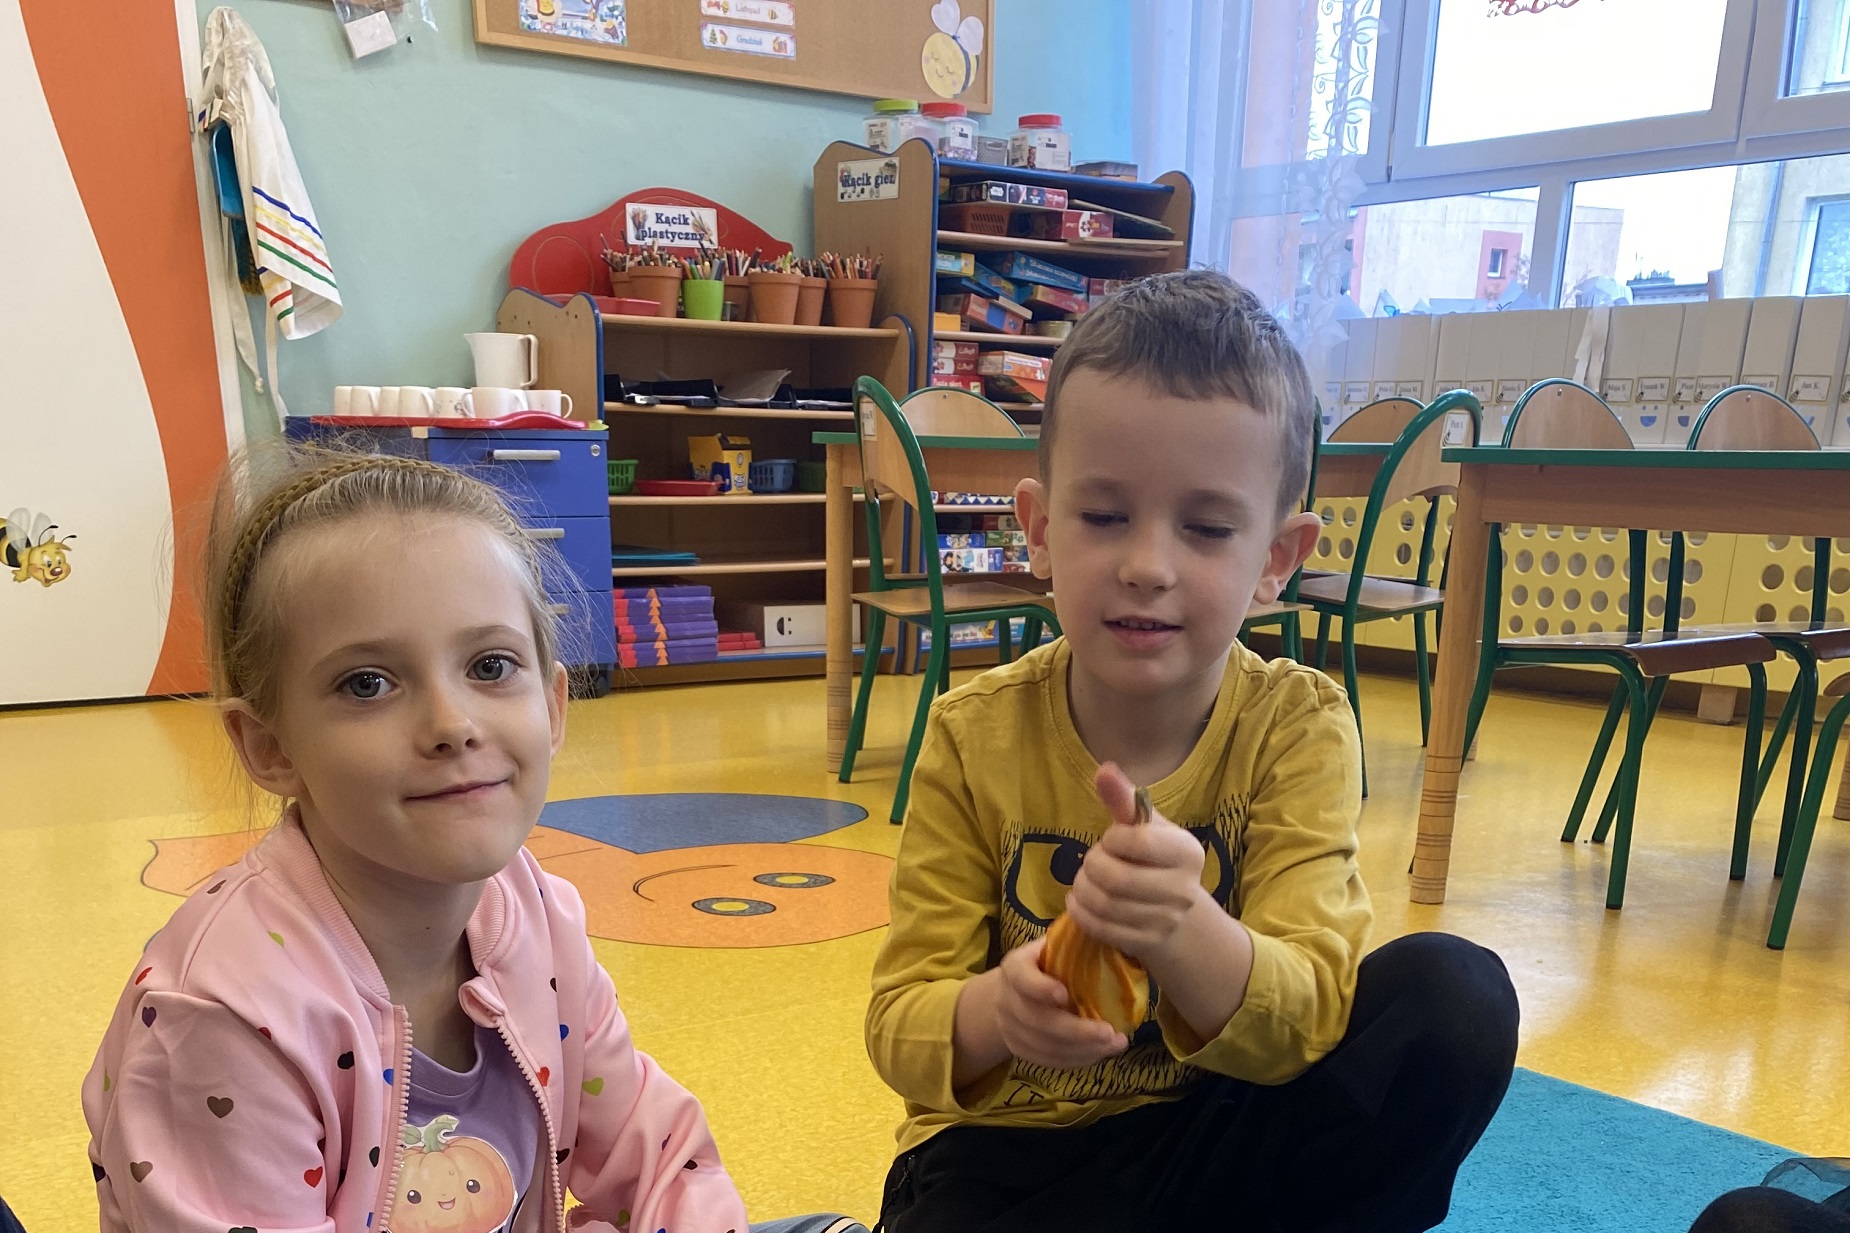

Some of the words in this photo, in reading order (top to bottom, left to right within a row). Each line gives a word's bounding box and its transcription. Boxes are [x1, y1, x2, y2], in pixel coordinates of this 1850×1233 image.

[842, 173, 871, 189] Kącik
[655, 212, 689, 227] Kącik
[641, 226, 704, 243] plastyczny
